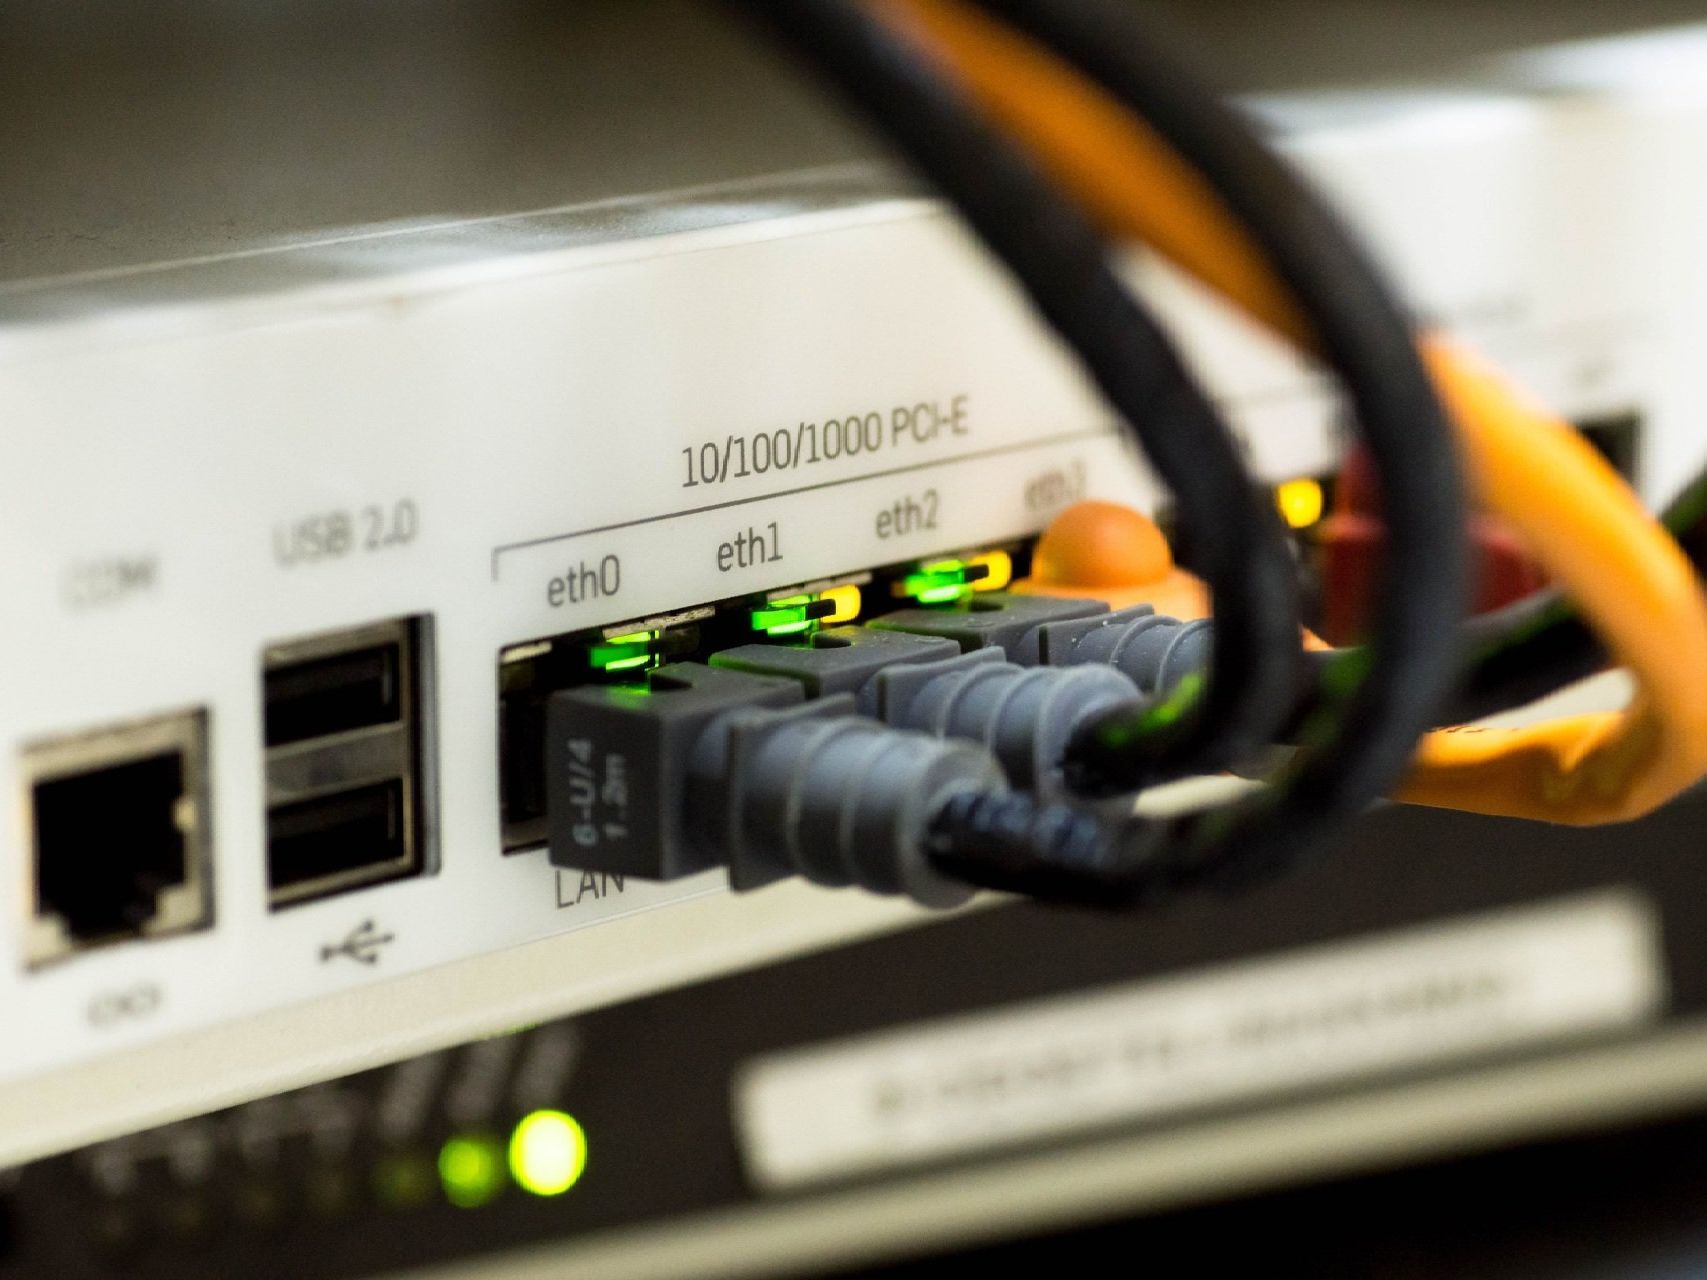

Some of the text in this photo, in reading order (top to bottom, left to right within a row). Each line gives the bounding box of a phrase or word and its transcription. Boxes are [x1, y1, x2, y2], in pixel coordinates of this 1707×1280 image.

[681, 394, 970, 488] 10/100/1000 PCI-E
[272, 498, 420, 568] USB 2.0
[875, 489, 940, 538] eth2
[716, 522, 784, 574] eth1
[547, 554, 621, 608] eth0
